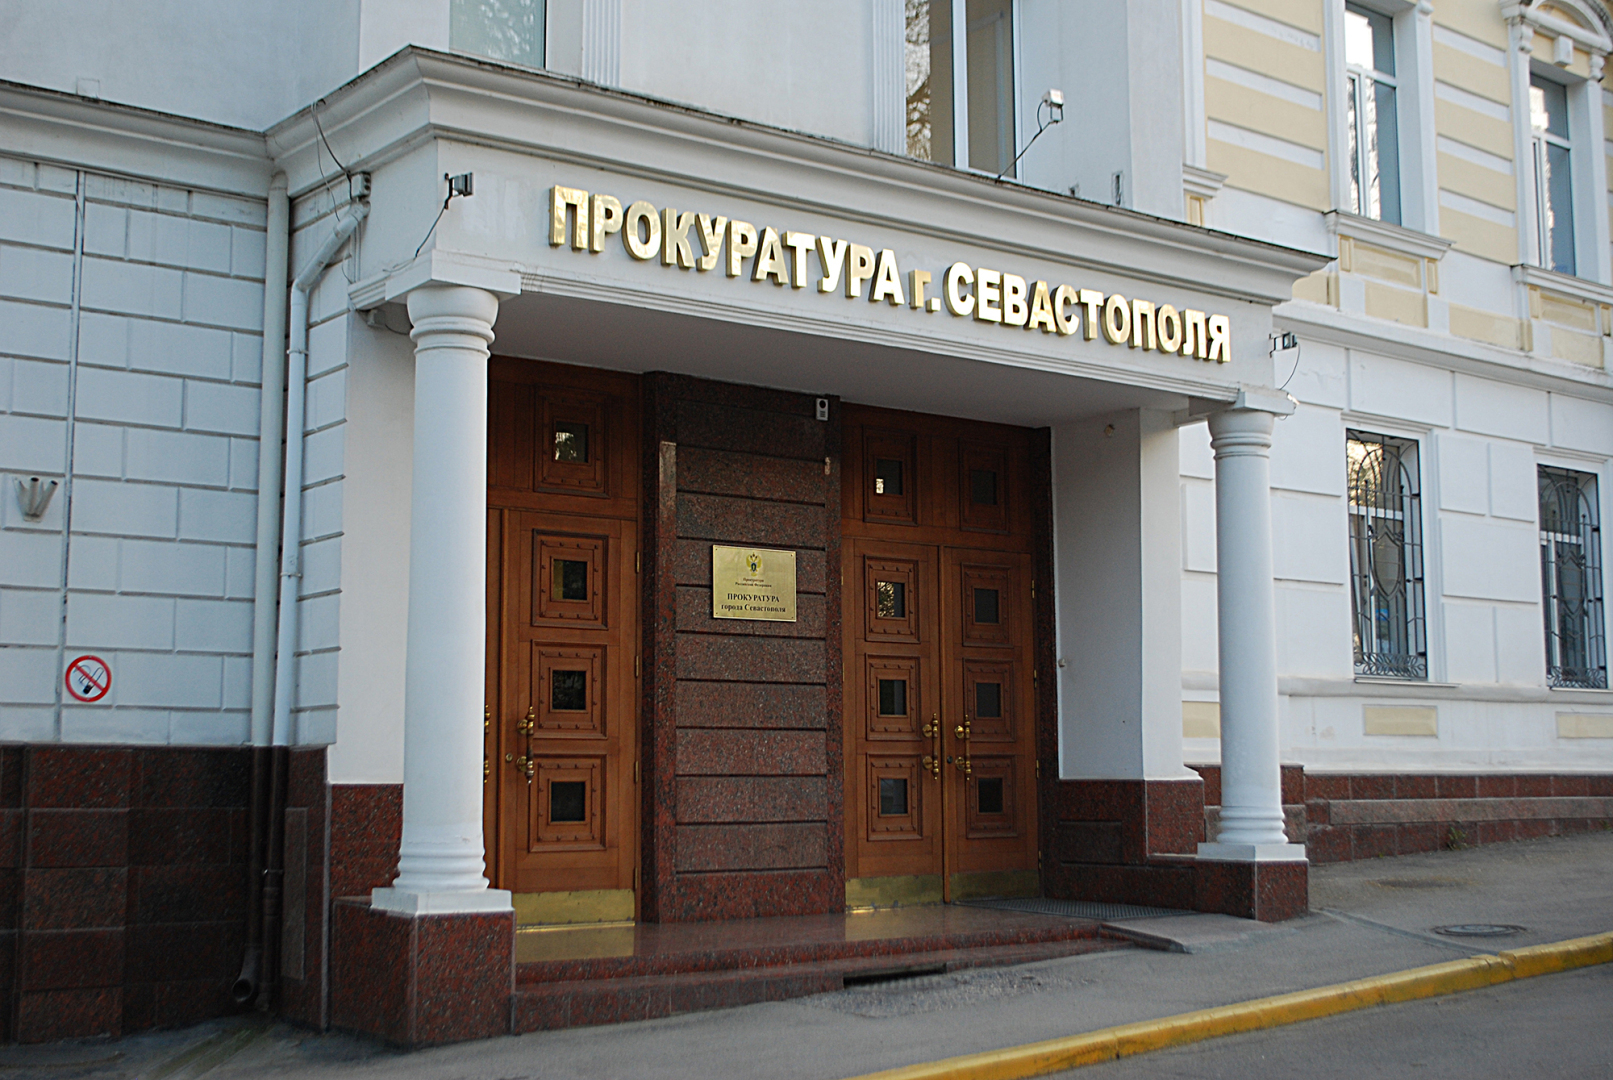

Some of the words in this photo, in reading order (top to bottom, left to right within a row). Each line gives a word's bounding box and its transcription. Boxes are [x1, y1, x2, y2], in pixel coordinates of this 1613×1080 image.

[549, 185, 905, 305] ПРОКУРАТУРА
[908, 269, 941, 312] г.
[943, 263, 1231, 362] СЕВАСТОПОЛЯ
[727, 593, 780, 602] ПРОКУРАТУРА
[744, 604, 786, 612] Севастополя
